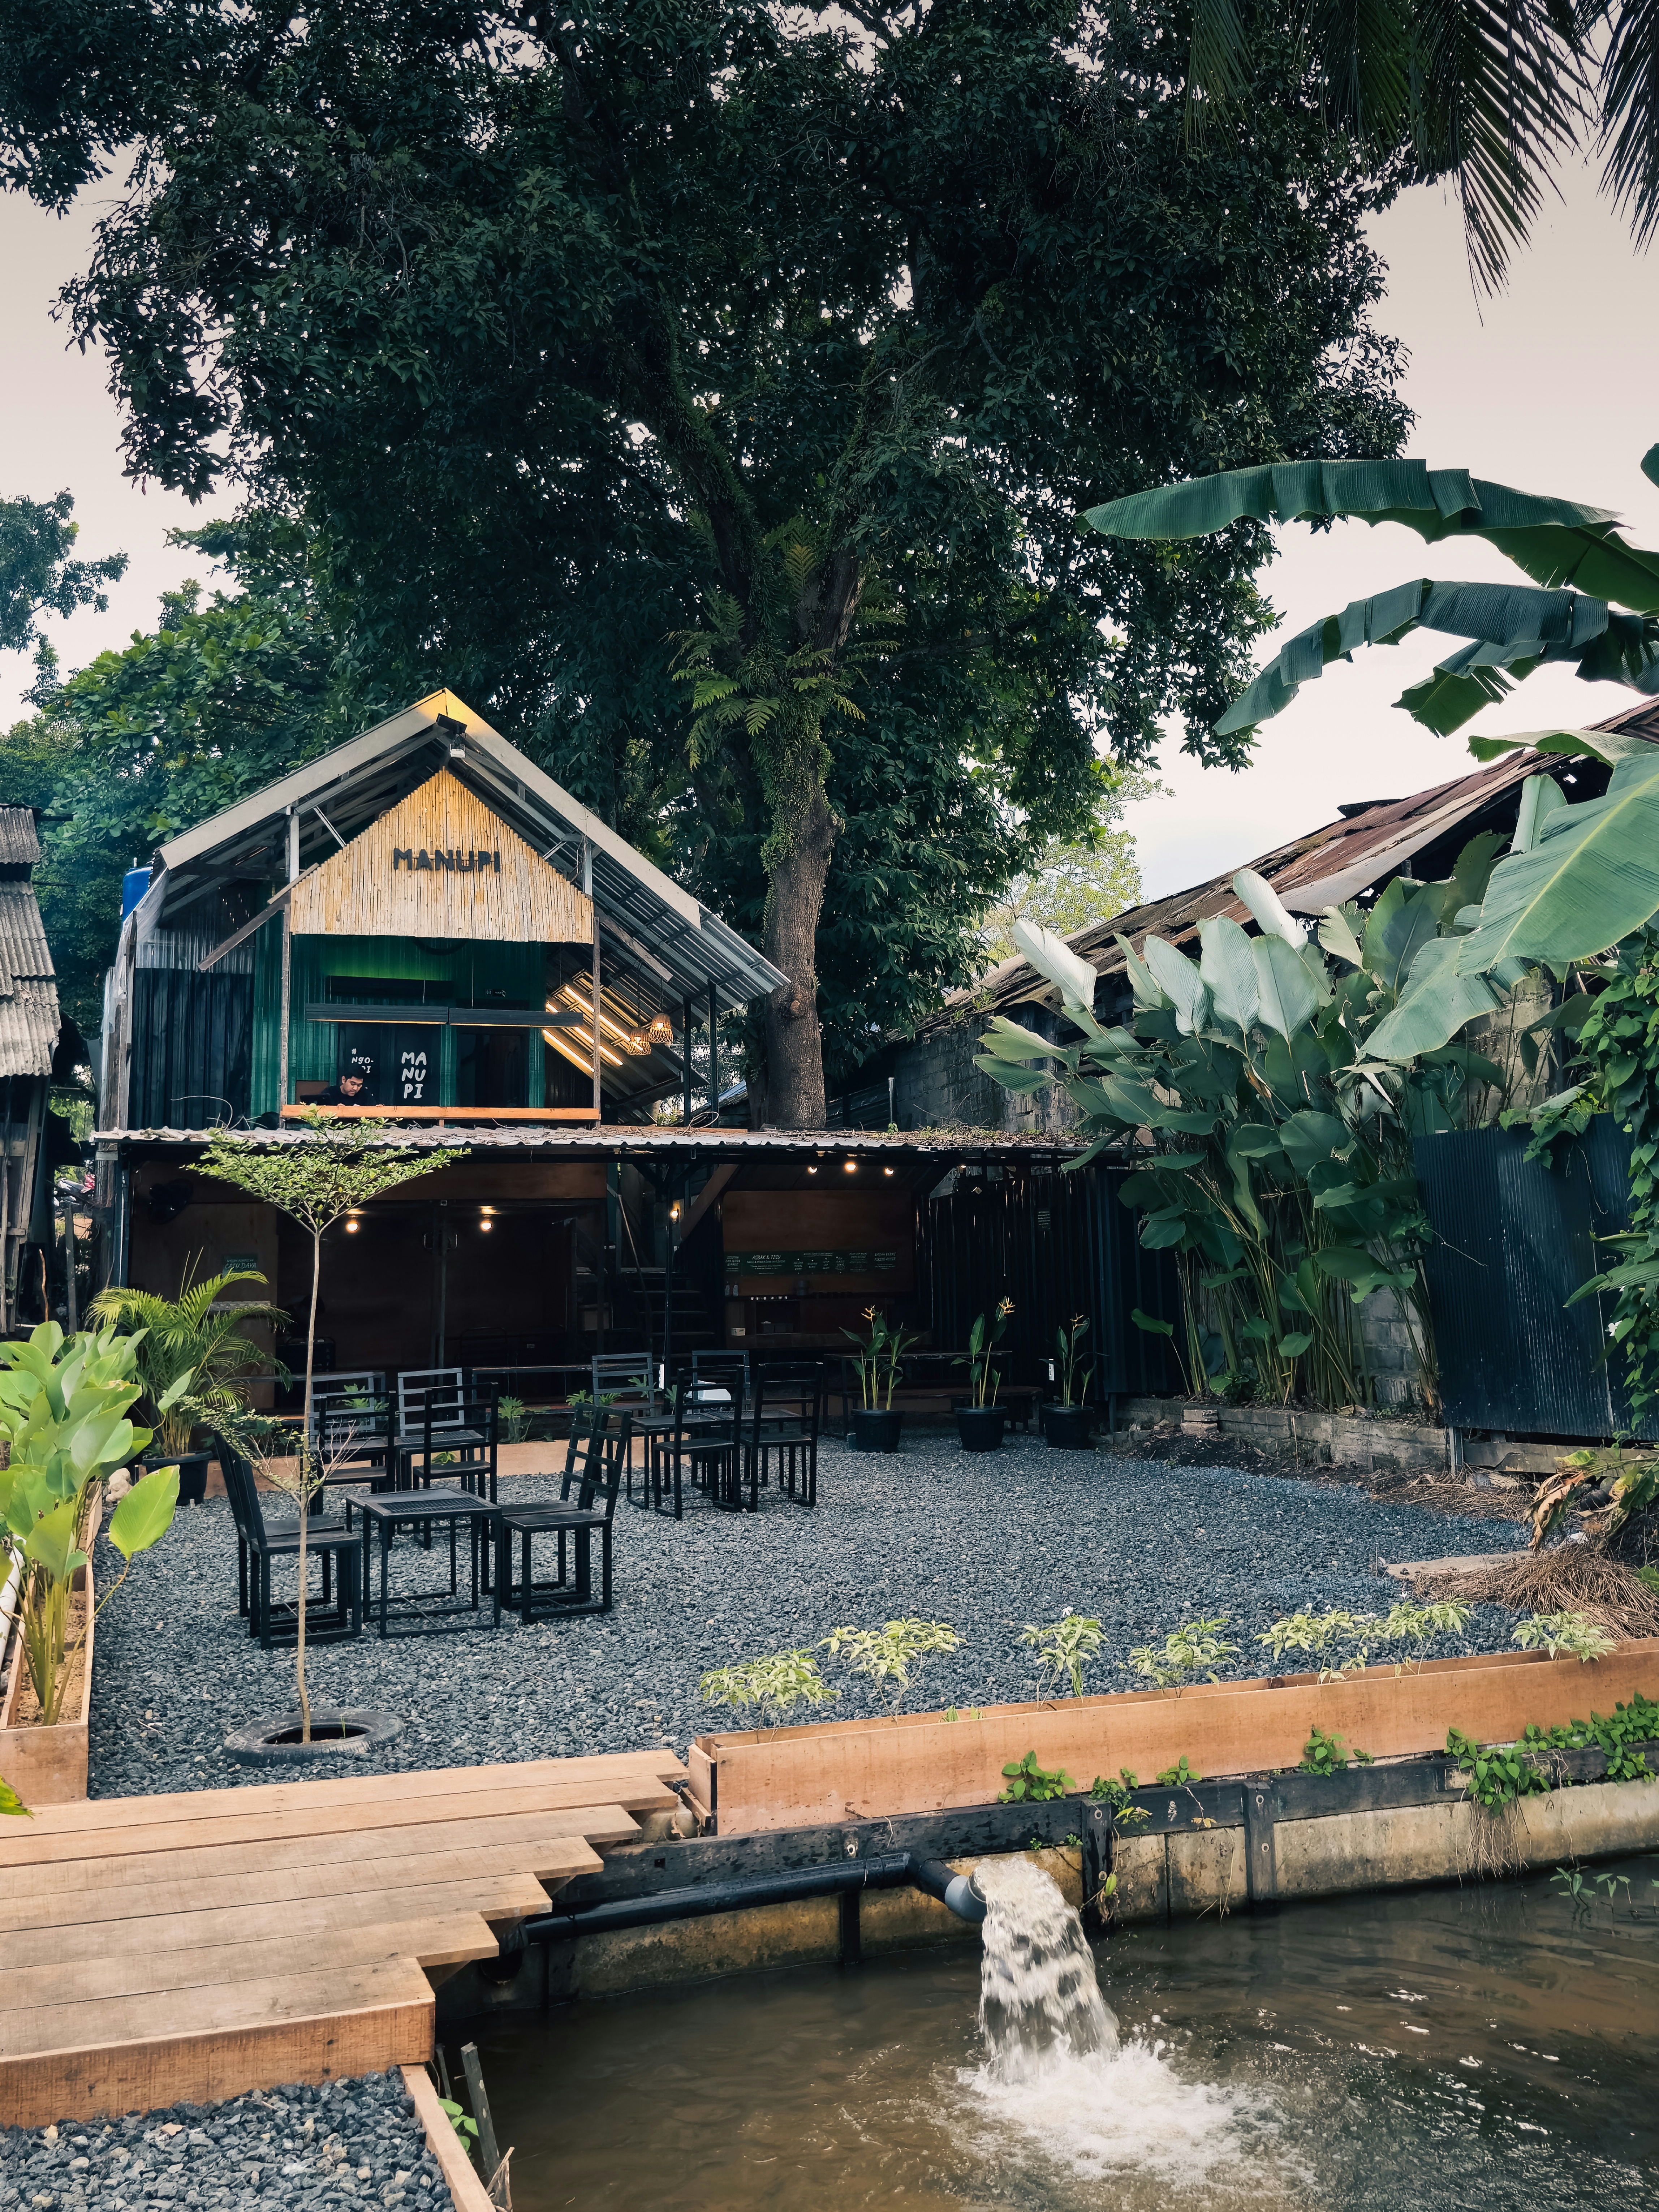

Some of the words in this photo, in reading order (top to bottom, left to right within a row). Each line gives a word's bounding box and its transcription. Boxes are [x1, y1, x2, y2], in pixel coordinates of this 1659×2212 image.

[393, 848, 501, 872] MANUPI
[401, 1052, 427, 1066] MA
[402, 1067, 426, 1081] NU
[404, 1083, 423, 1099] PI
